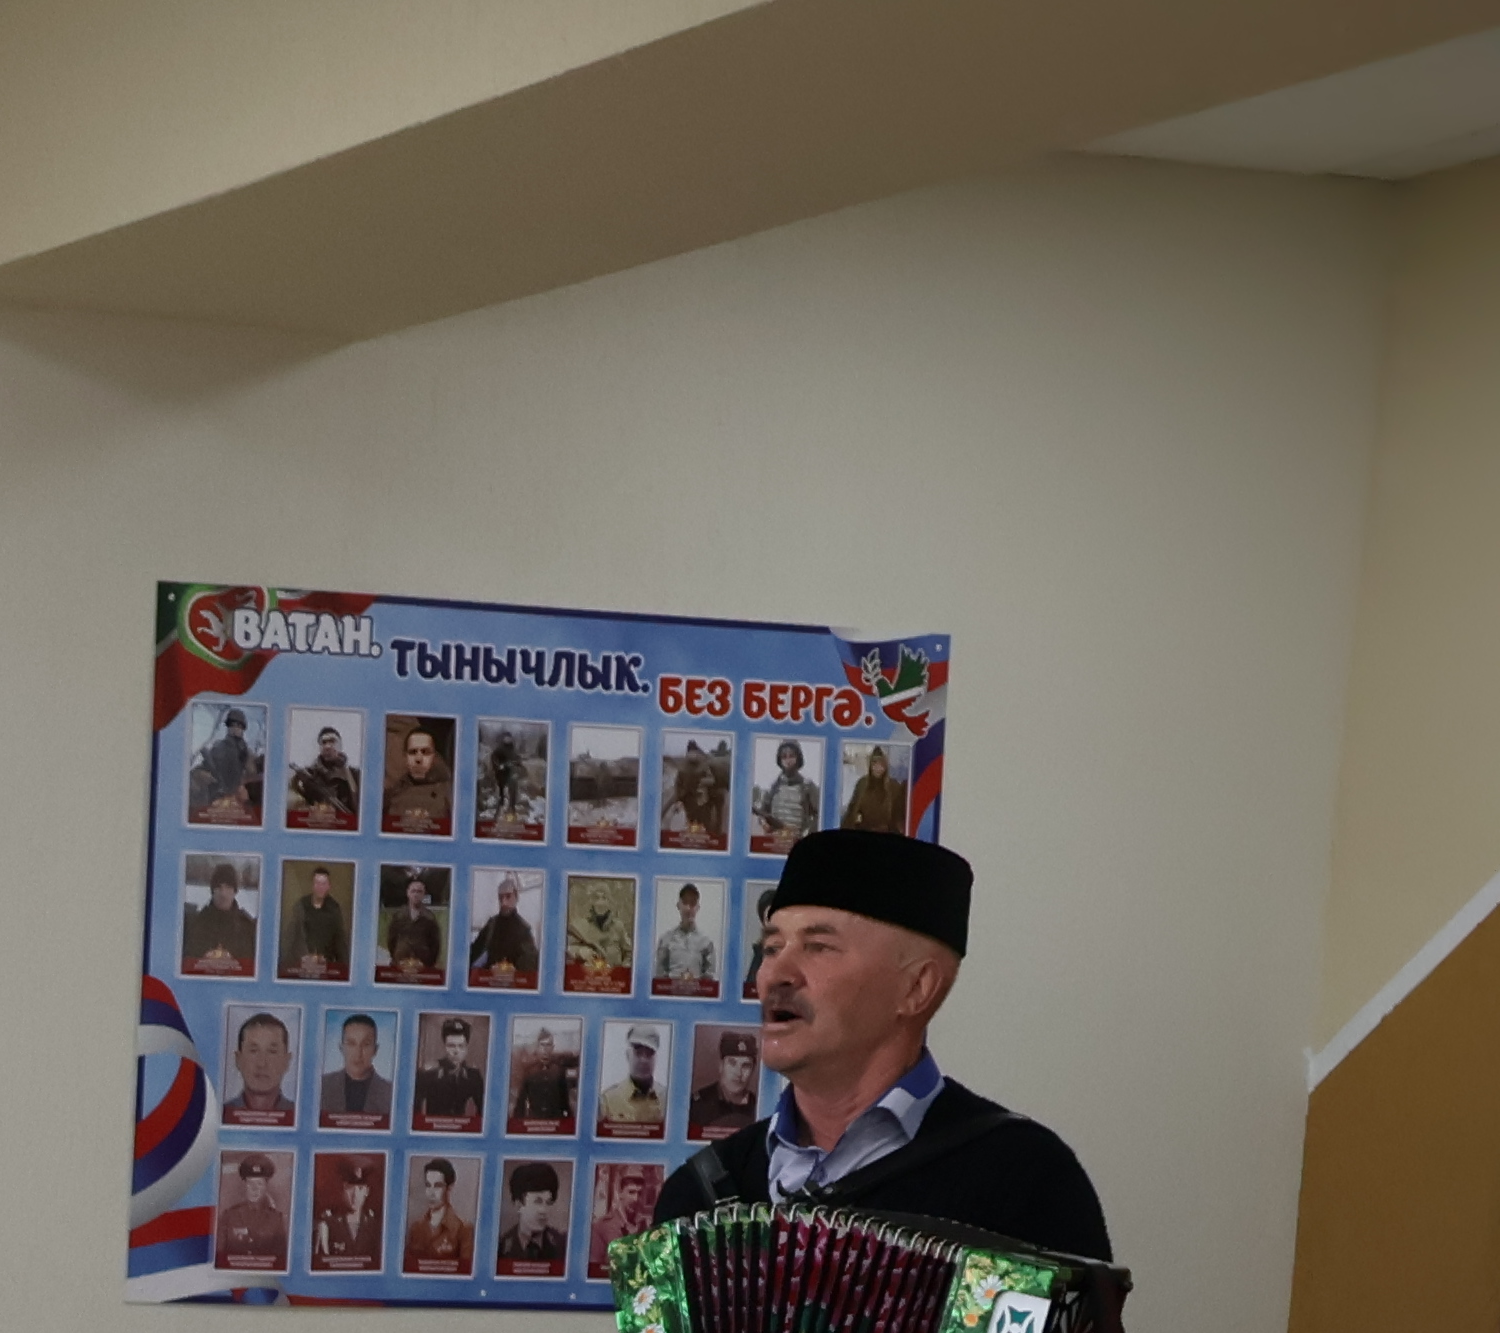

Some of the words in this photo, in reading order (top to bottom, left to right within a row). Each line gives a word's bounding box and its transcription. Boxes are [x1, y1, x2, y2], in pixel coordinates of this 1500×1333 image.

[232, 606, 383, 658] ВАТАН.
[391, 638, 650, 694] ТЫНЫЧЛЫК.
[658, 676, 731, 717] БЕЗ
[742, 681, 874, 728] БЕРГӘ.
